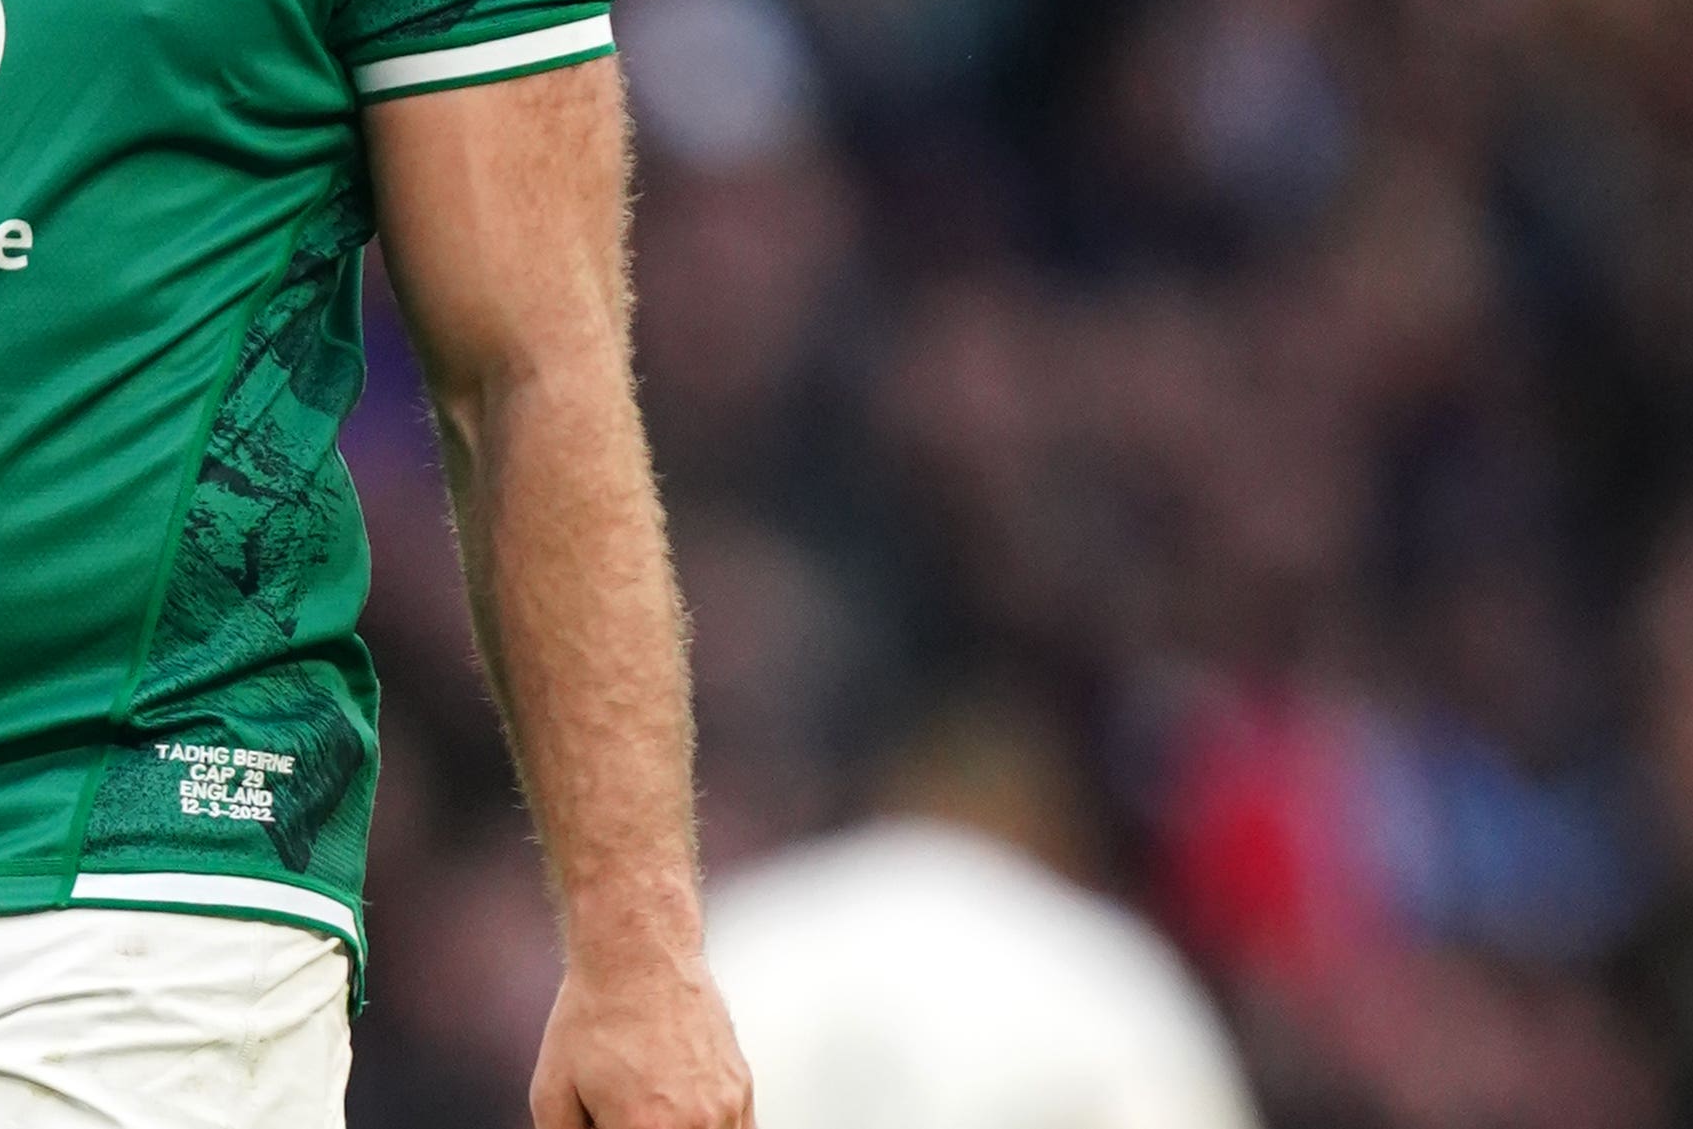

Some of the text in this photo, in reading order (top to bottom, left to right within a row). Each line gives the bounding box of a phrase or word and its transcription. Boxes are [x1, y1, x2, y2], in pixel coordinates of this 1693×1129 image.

[155, 743, 229, 764] TADHG
[190, 764, 264, 787] CAP 29
[180, 780, 272, 806] ENGLAND
[181, 798, 275, 821] 12-3-2022
